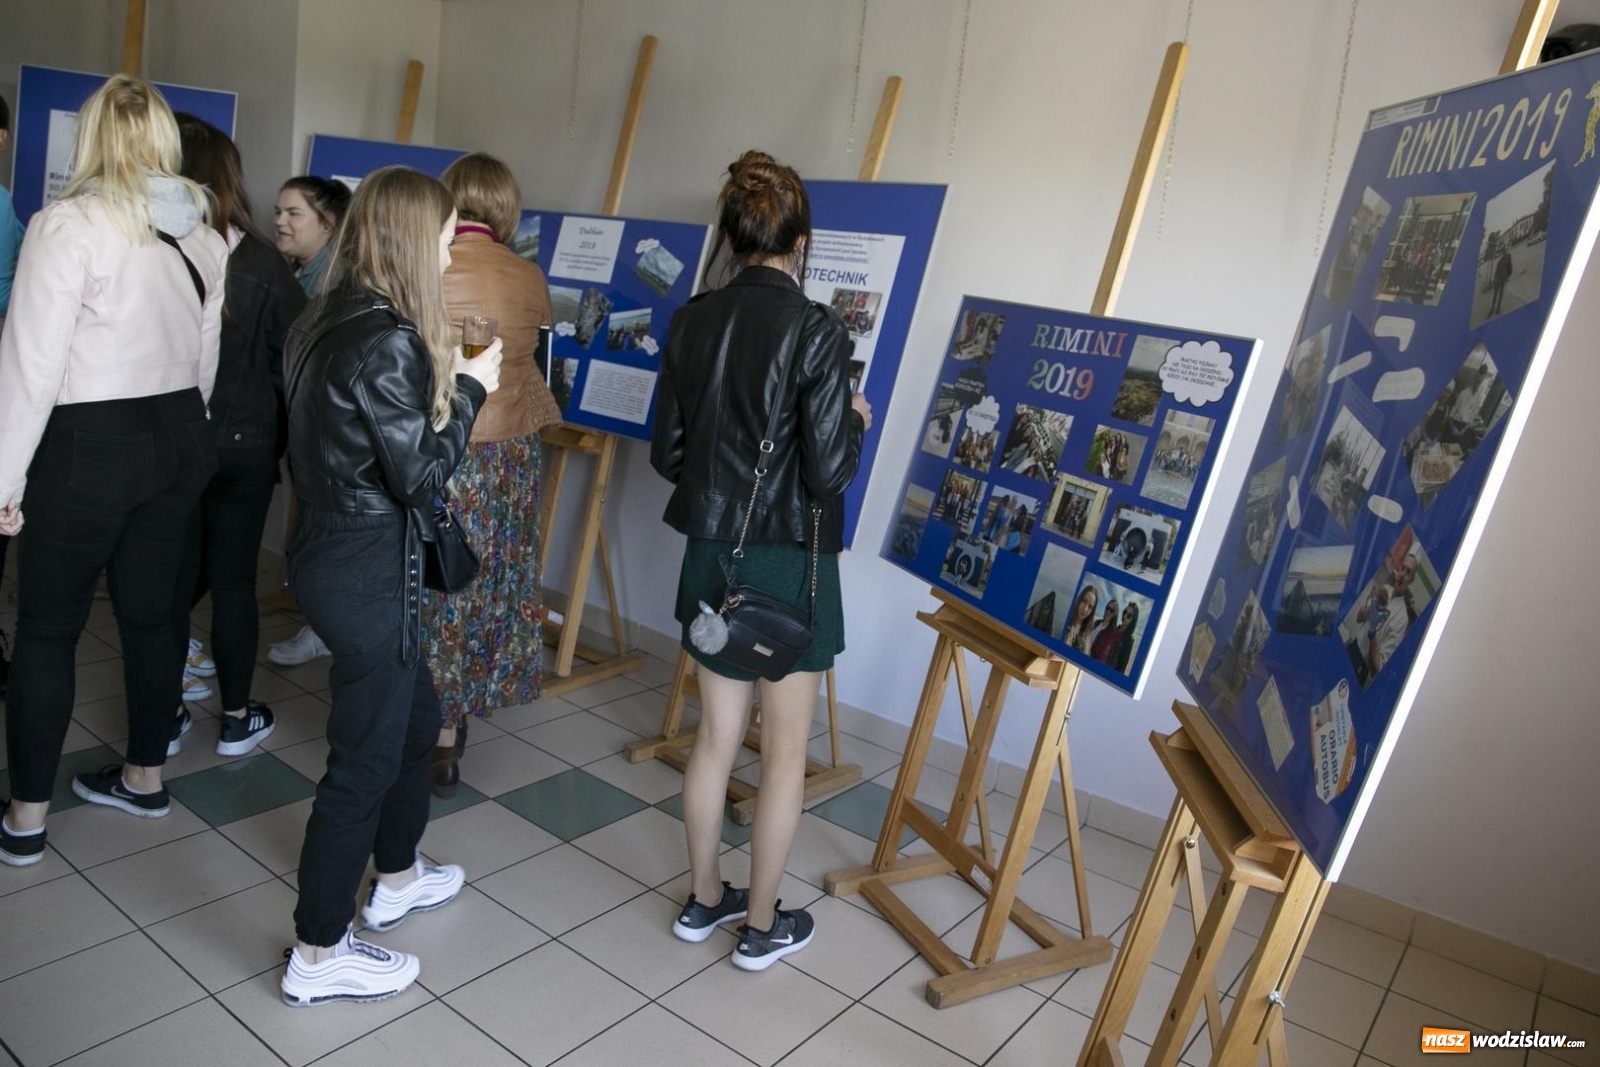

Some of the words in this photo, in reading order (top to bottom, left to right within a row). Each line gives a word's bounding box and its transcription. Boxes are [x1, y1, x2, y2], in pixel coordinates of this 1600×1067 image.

[804, 266, 868, 286] OTECHNIK
[1030, 323, 1129, 358] RIMINI
[1027, 359, 1096, 401] 2019
[1320, 734, 1331, 800] AUTOBUS
[1329, 729, 1339, 785] ORARIO
